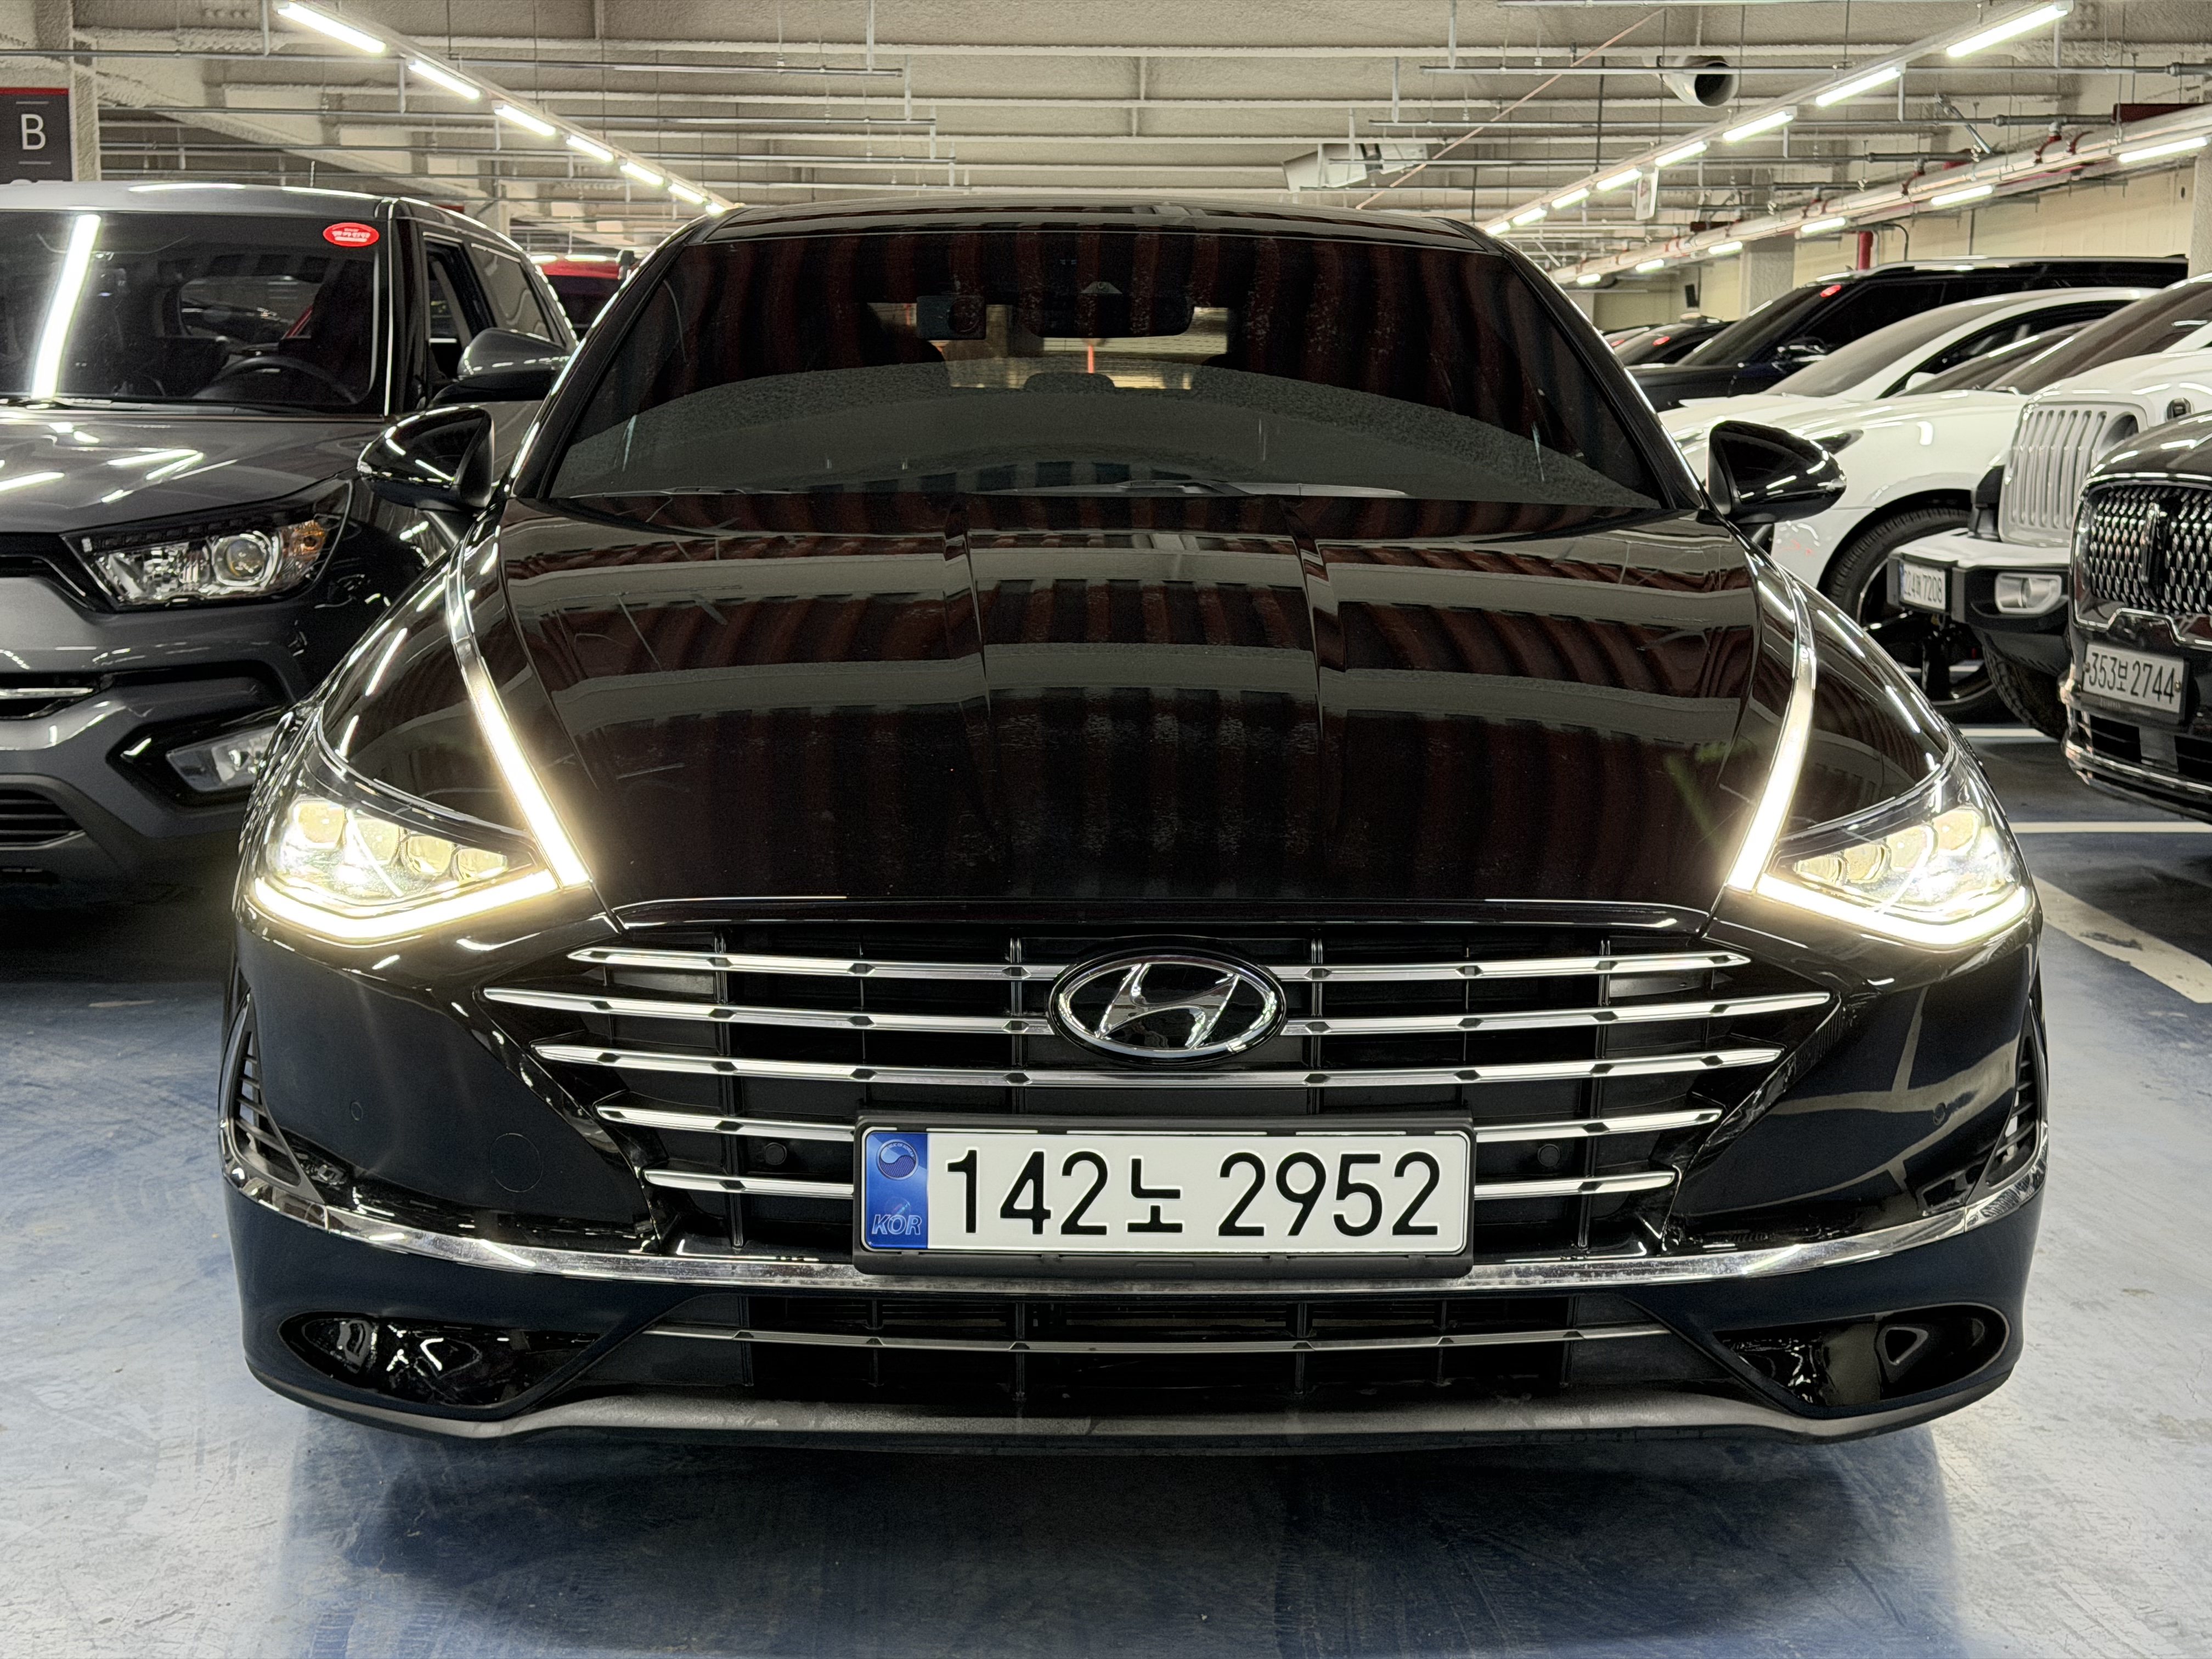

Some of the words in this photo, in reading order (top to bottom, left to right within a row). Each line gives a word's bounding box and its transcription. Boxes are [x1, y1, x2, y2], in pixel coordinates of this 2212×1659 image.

[21, 114, 46, 150] B
[2089, 652, 2129, 692] 353보
[2130, 660, 2175, 704] 2744
[947, 1149, 1183, 1235] 142노
[1217, 1151, 1441, 1237] 2952
[872, 1214, 922, 1235] KOR
